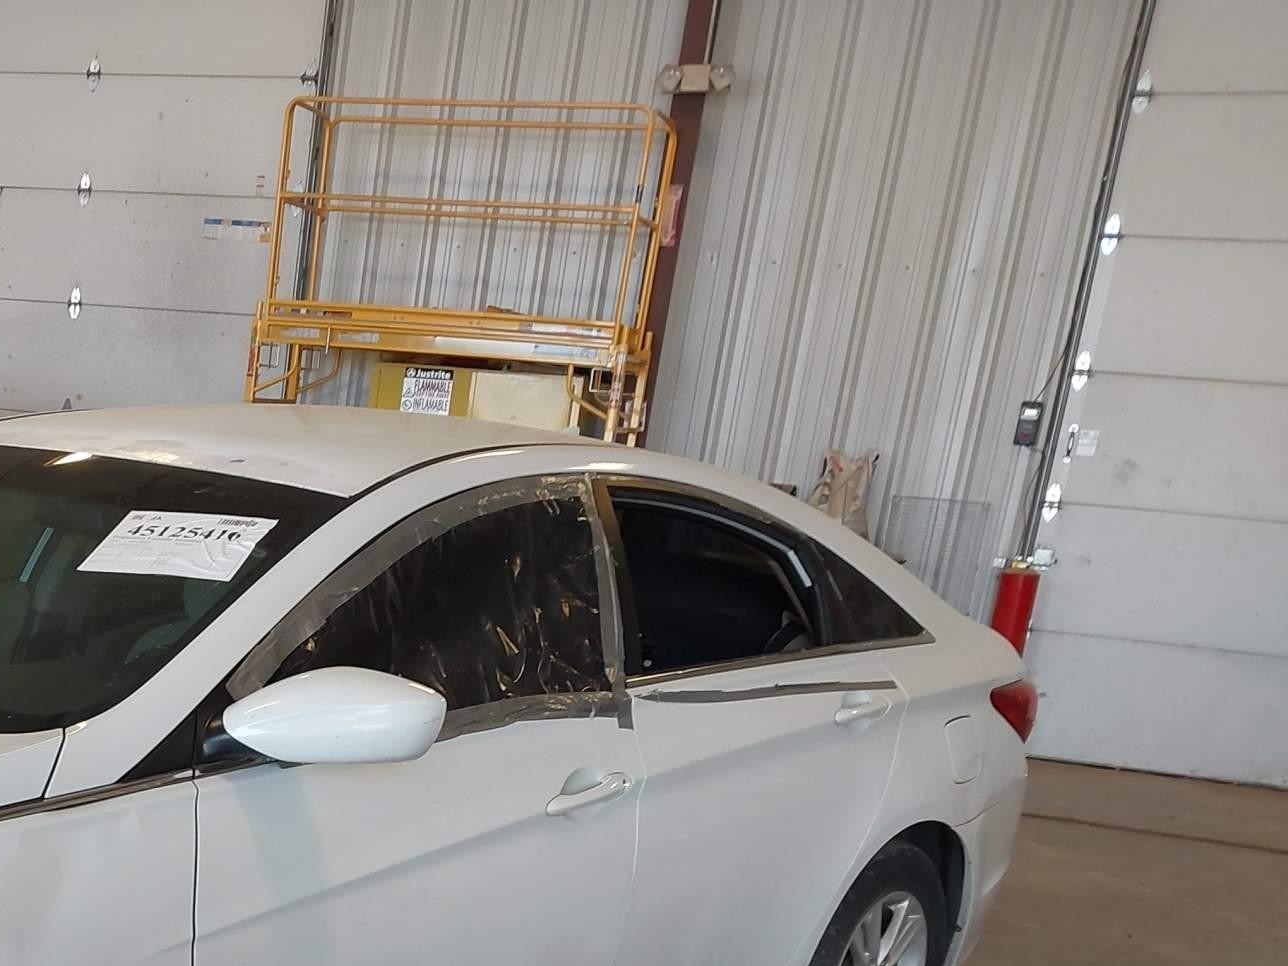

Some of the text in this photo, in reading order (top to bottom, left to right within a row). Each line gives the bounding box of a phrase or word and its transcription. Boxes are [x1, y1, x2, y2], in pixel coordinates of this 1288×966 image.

[416, 369, 451, 380] Justrite
[414, 379, 451, 393] FLAMMABLE
[413, 398, 449, 412] INFLAMABLE
[127, 524, 242, 542] 45125416
